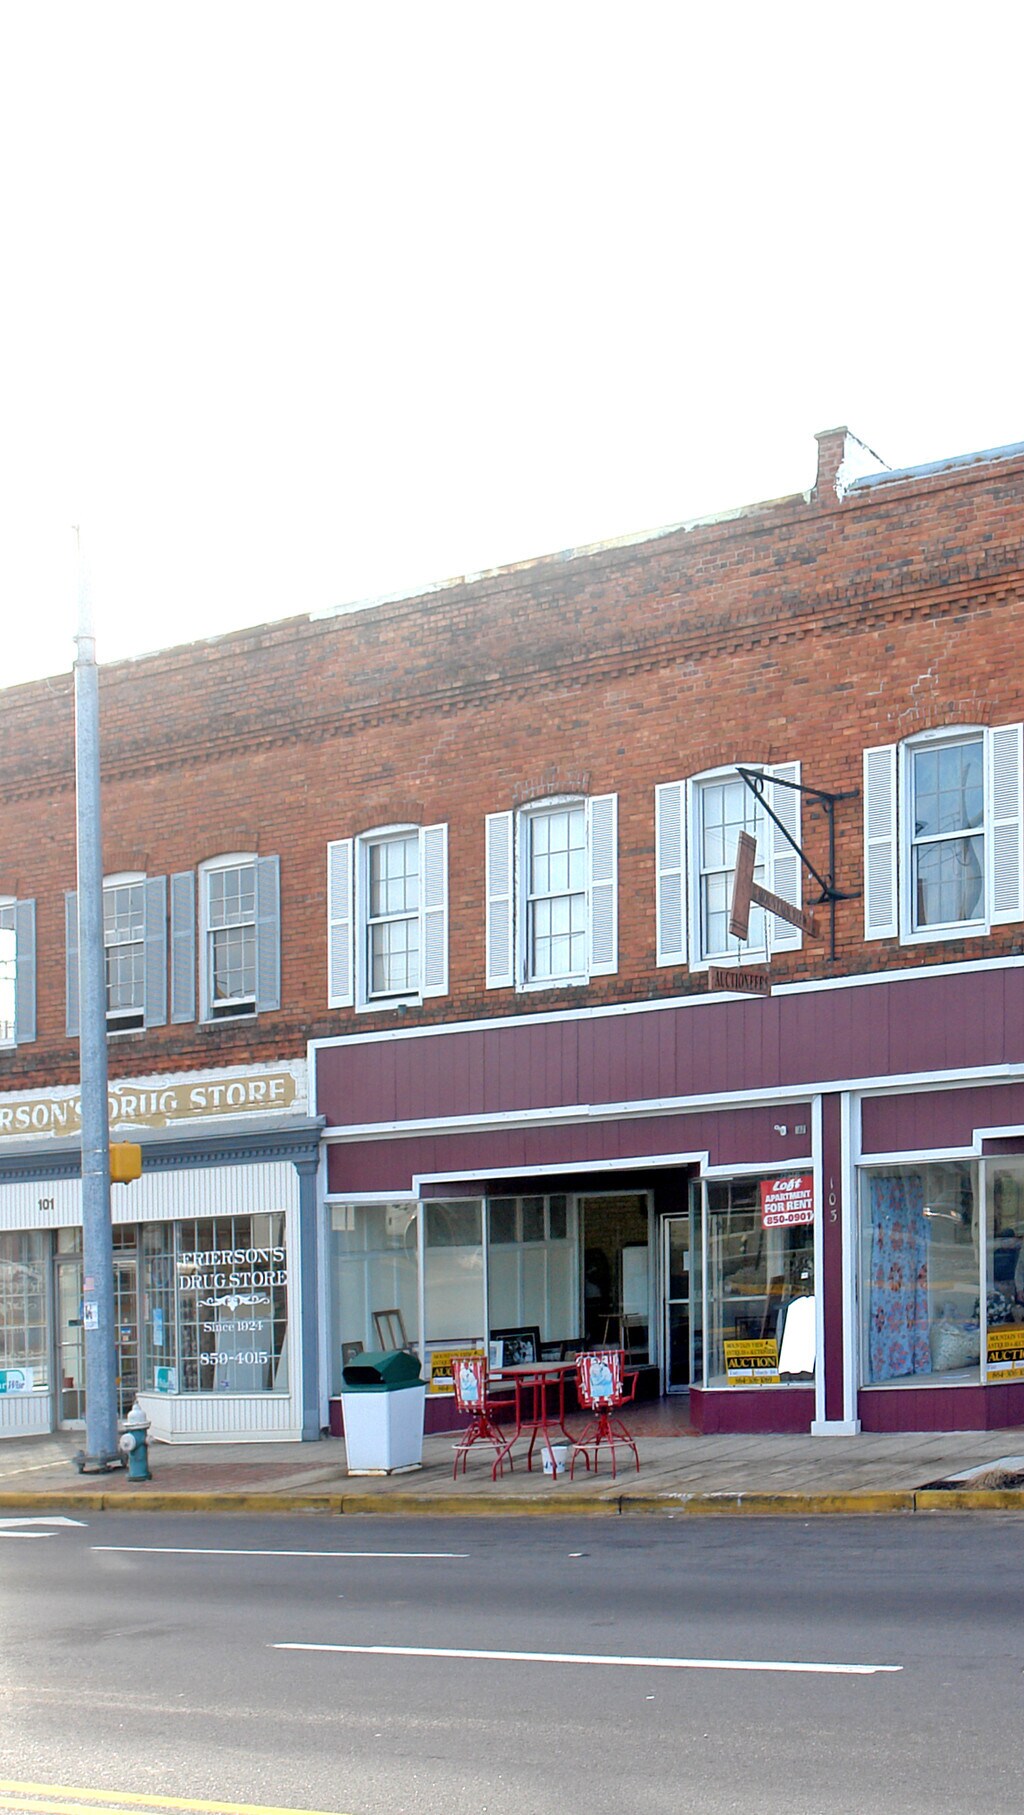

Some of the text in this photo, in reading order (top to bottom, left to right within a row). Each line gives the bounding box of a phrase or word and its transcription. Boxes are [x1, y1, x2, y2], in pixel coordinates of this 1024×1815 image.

[189, 1079, 286, 1112] STORE
[772, 1178, 803, 1191] Loft
[765, 1190, 811, 1202] APARTMENT
[38, 1198, 55, 1211] 101
[764, 1199, 813, 1213] FOR RENT
[766, 1212, 811, 1224] 850-0901
[182, 1246, 285, 1266] FRIERSON'S
[180, 1270, 288, 1290] DRUG STORE
[203, 1321, 235, 1332] Since
[200, 1351, 269, 1366] 859-4015
[728, 1357, 776, 1368] AUCTION
